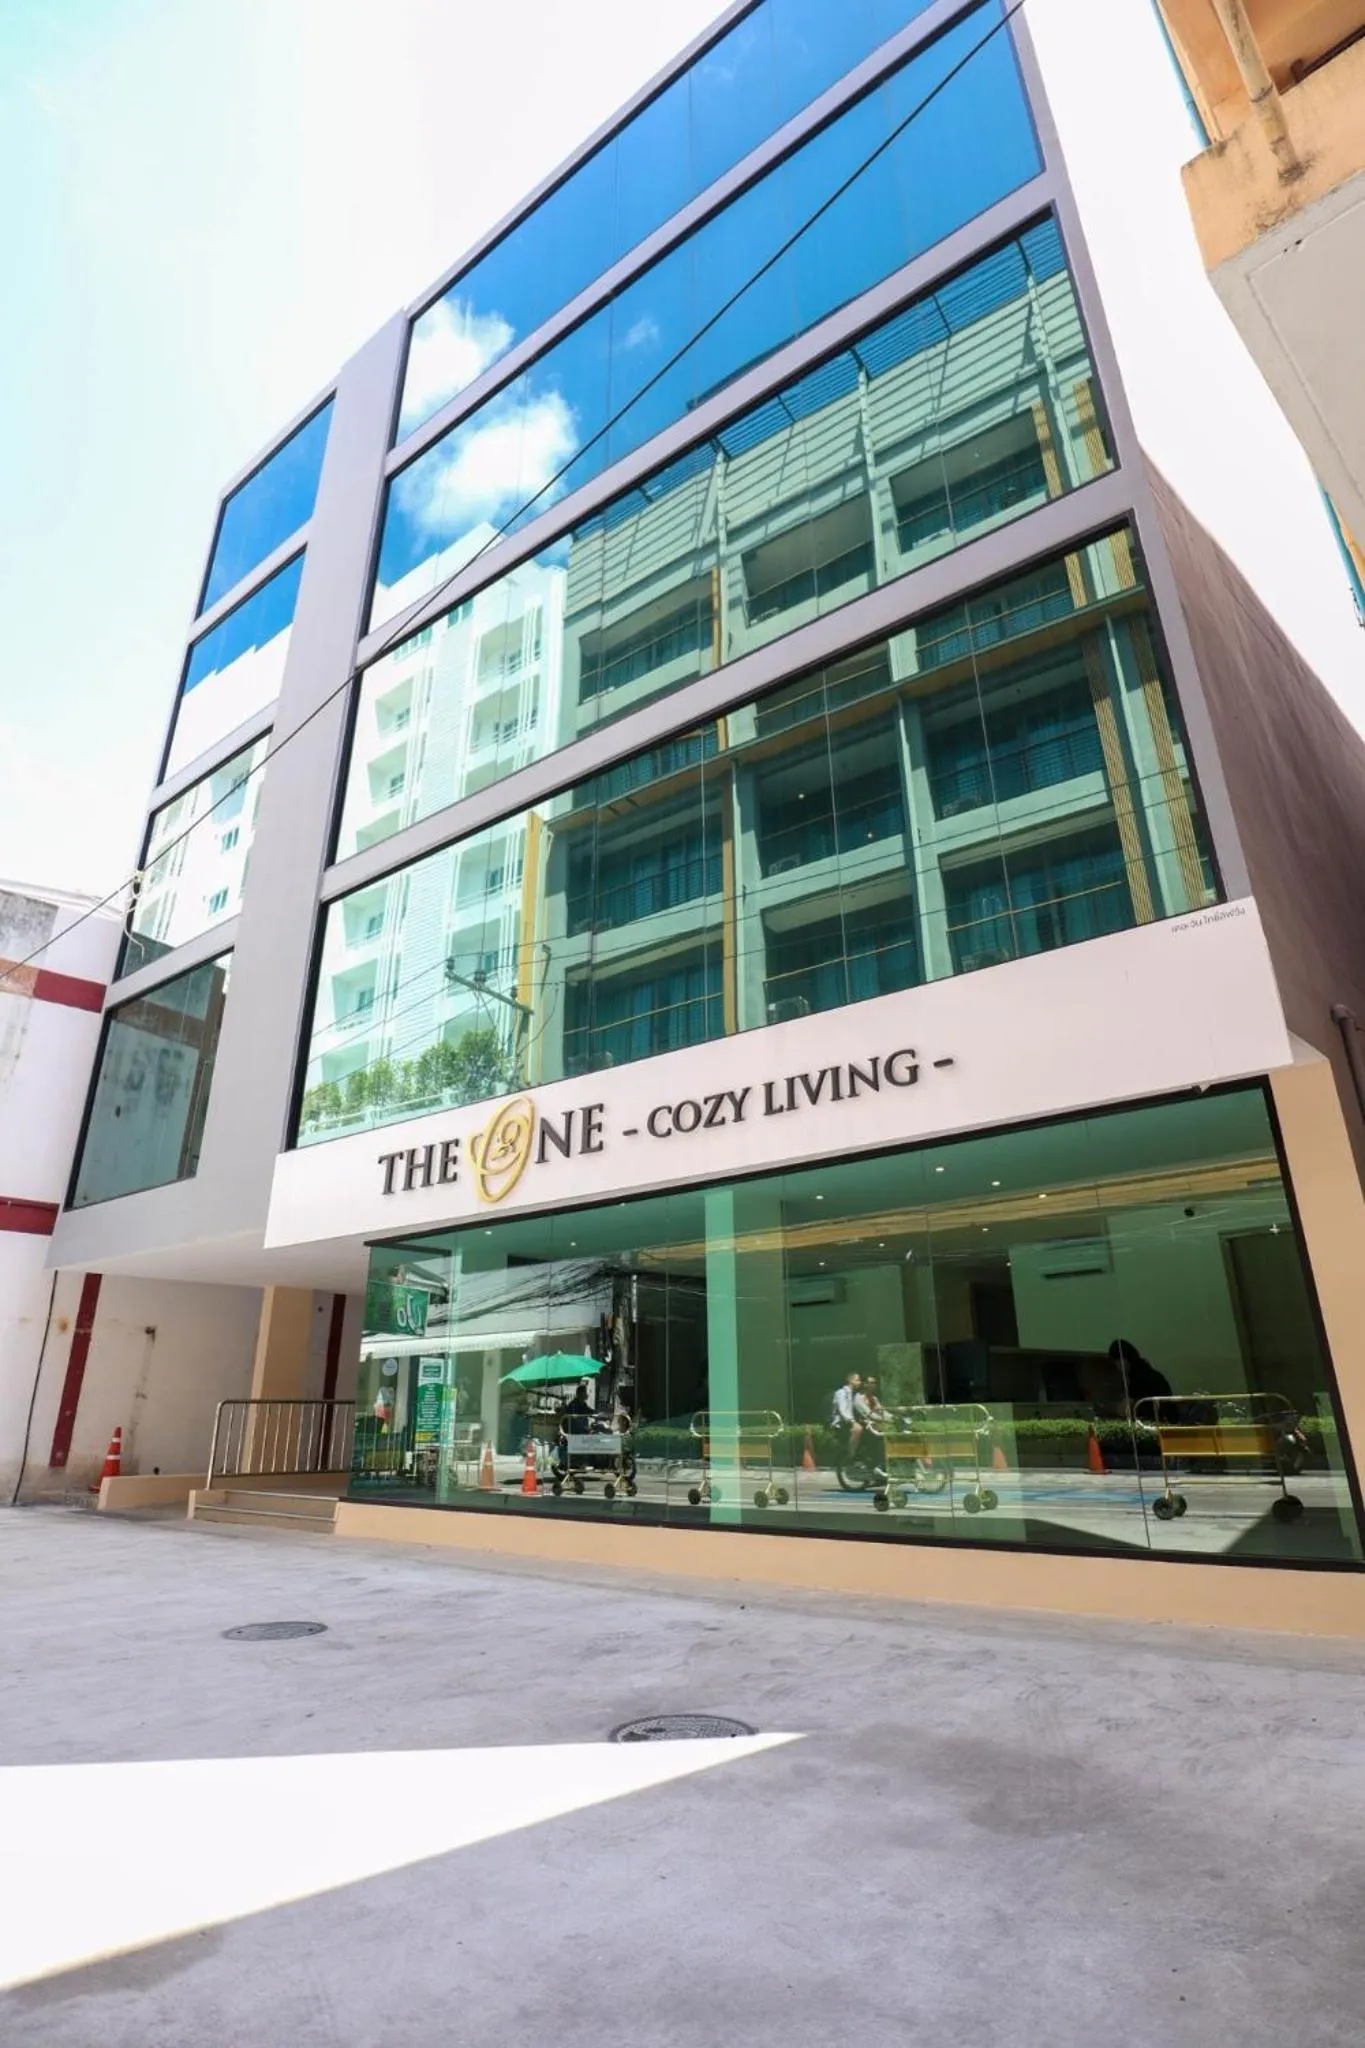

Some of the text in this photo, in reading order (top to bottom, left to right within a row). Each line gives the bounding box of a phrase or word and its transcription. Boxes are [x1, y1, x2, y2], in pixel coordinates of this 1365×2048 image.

[377, 1138, 460, 1195] THE
[647, 1087, 752, 1138] COZY
[762, 1049, 920, 1116] LIVING
